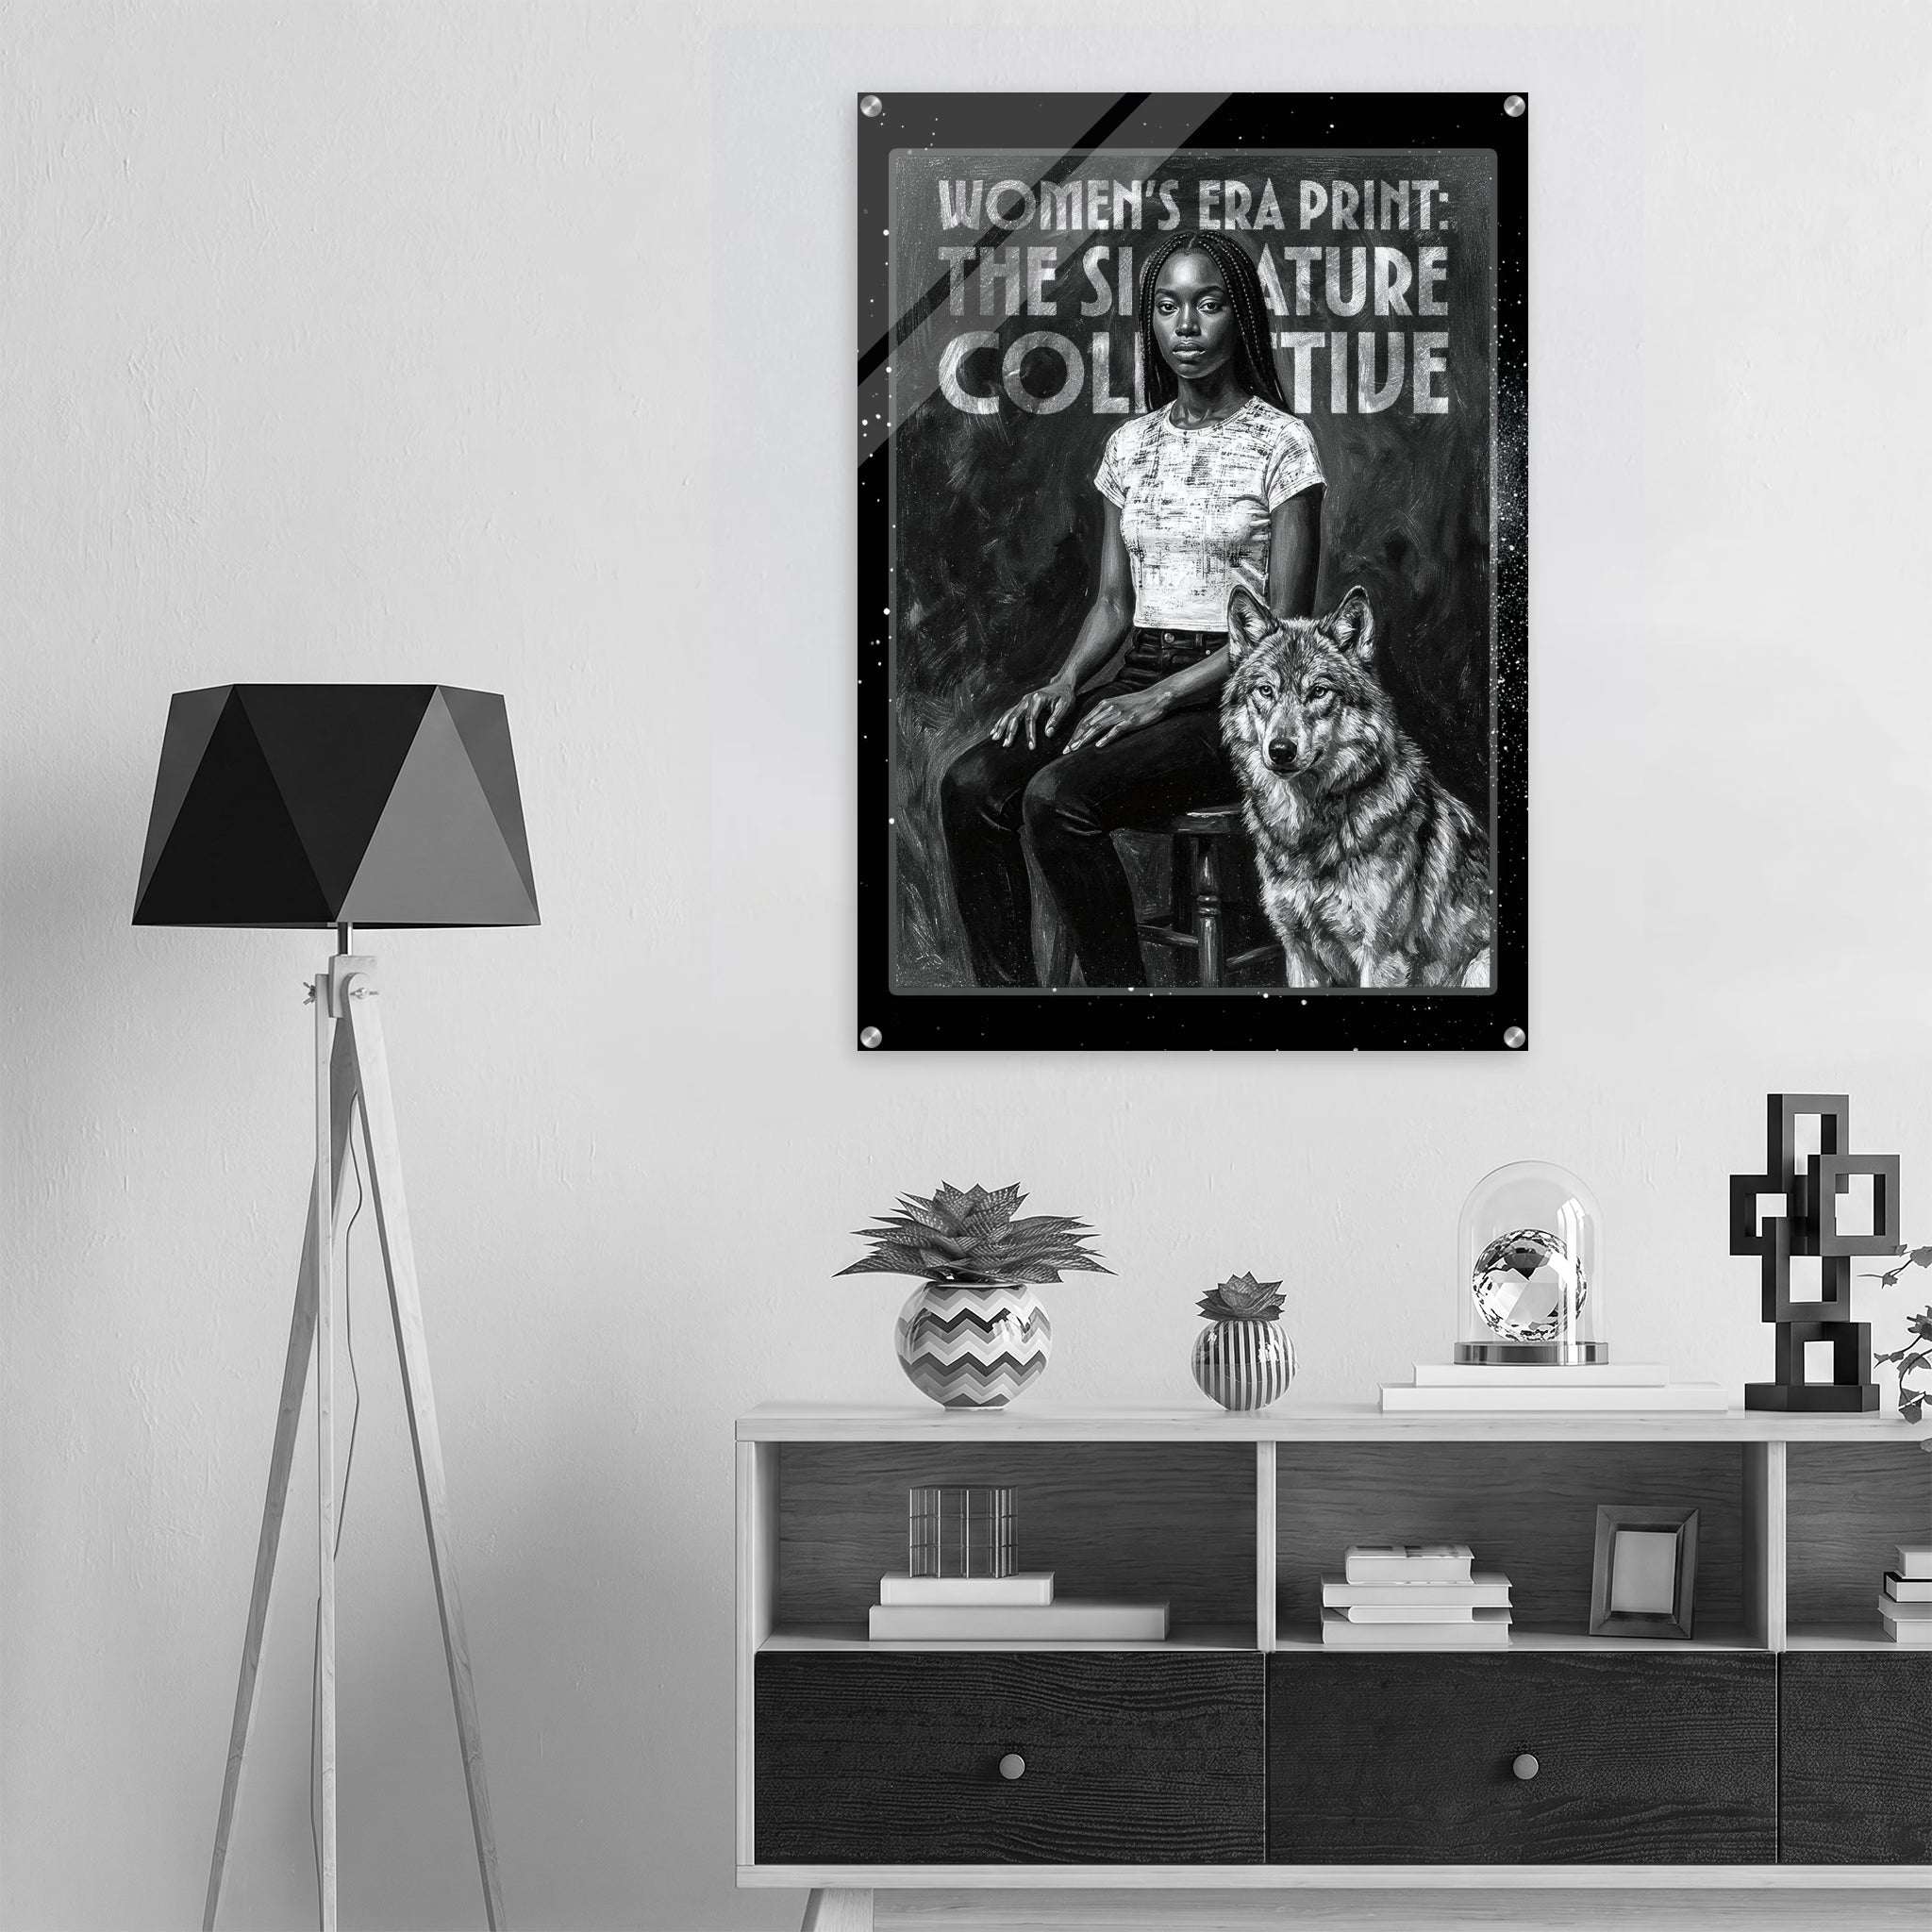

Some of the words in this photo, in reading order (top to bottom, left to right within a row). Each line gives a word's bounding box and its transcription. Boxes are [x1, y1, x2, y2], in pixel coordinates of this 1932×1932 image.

[938, 179, 1180, 231] WOMEN'S
[1198, 177, 1286, 231] ERA
[1299, 179, 1449, 231] PRINT:
[938, 246, 1058, 317] THE
[1080, 242, 1449, 318] SIATURE
